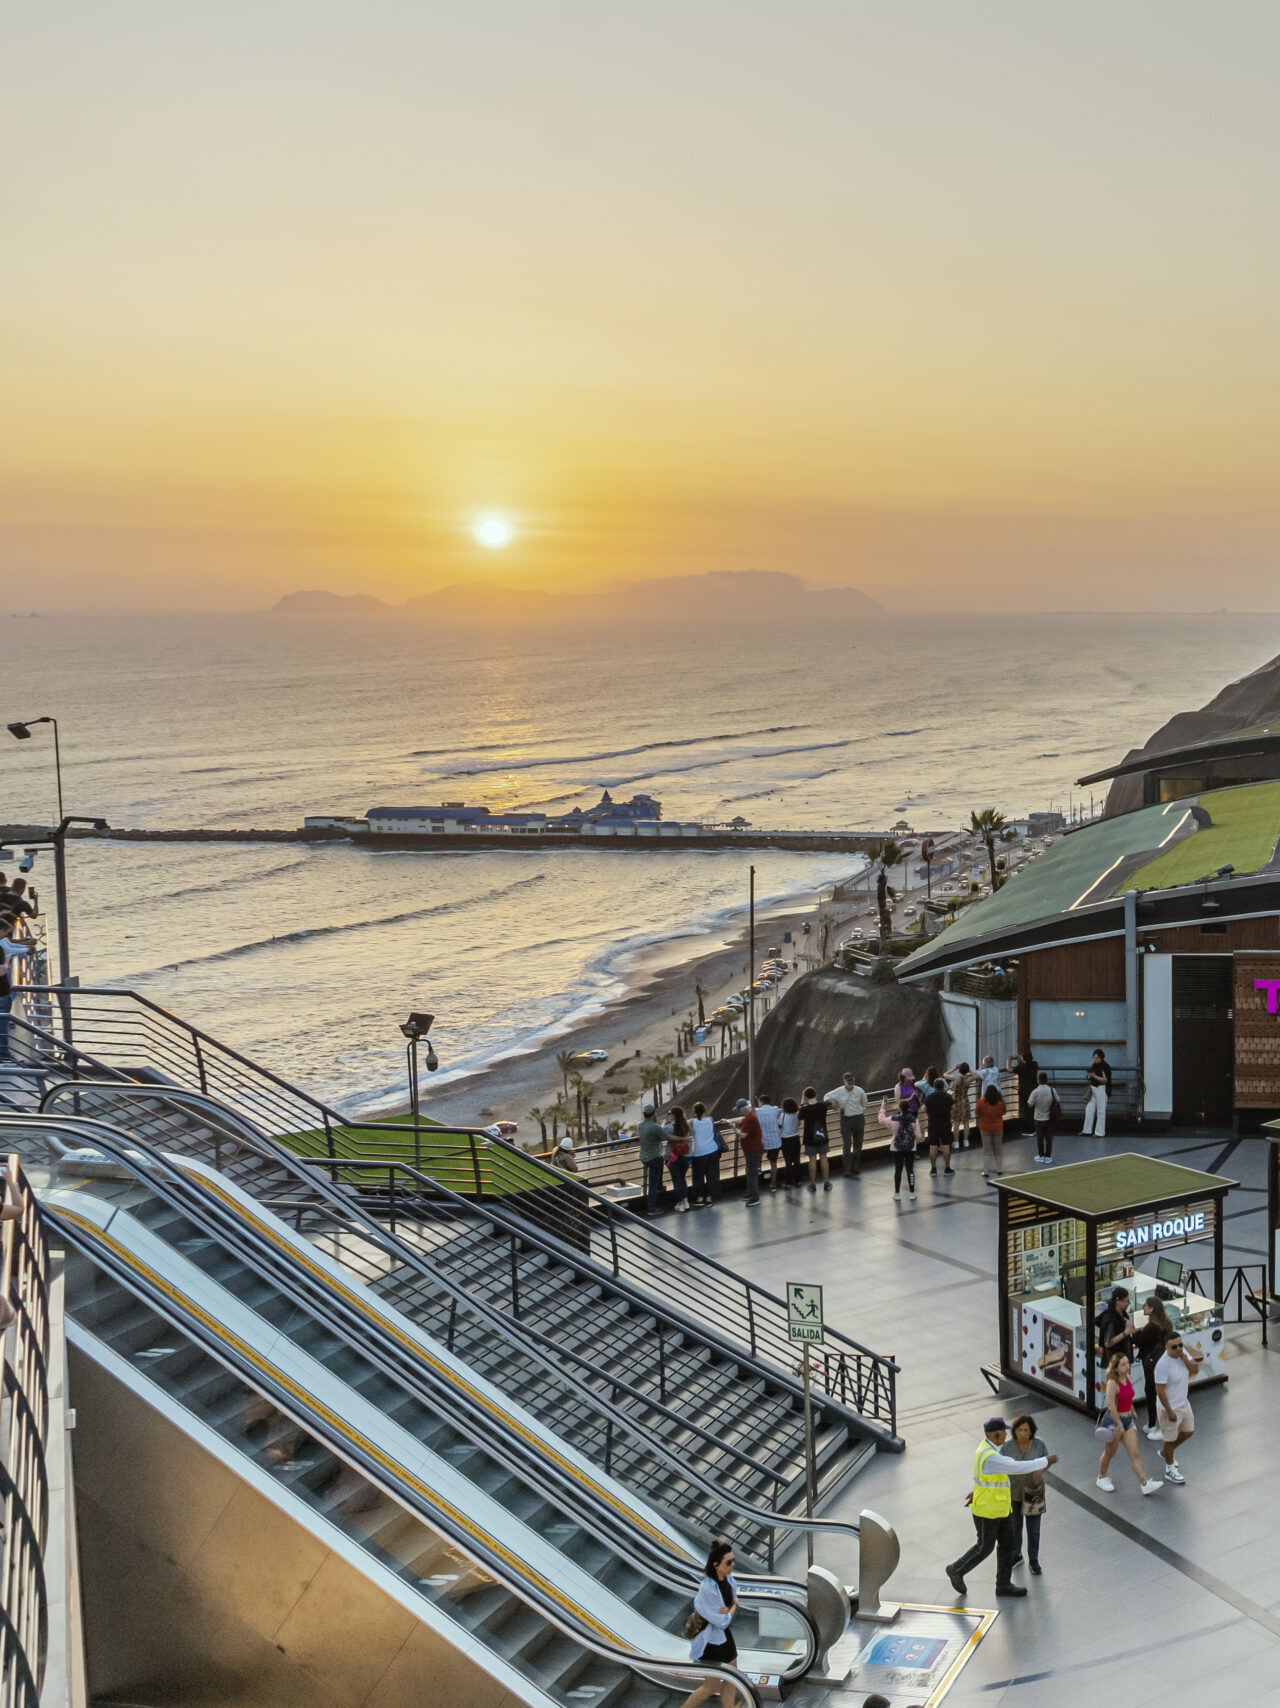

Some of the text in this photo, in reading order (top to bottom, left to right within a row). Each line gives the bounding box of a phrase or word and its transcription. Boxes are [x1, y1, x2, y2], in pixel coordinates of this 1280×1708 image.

[1115, 1212, 1205, 1249] SAN ROQUE
[791, 1327, 821, 1341] SALIDA
